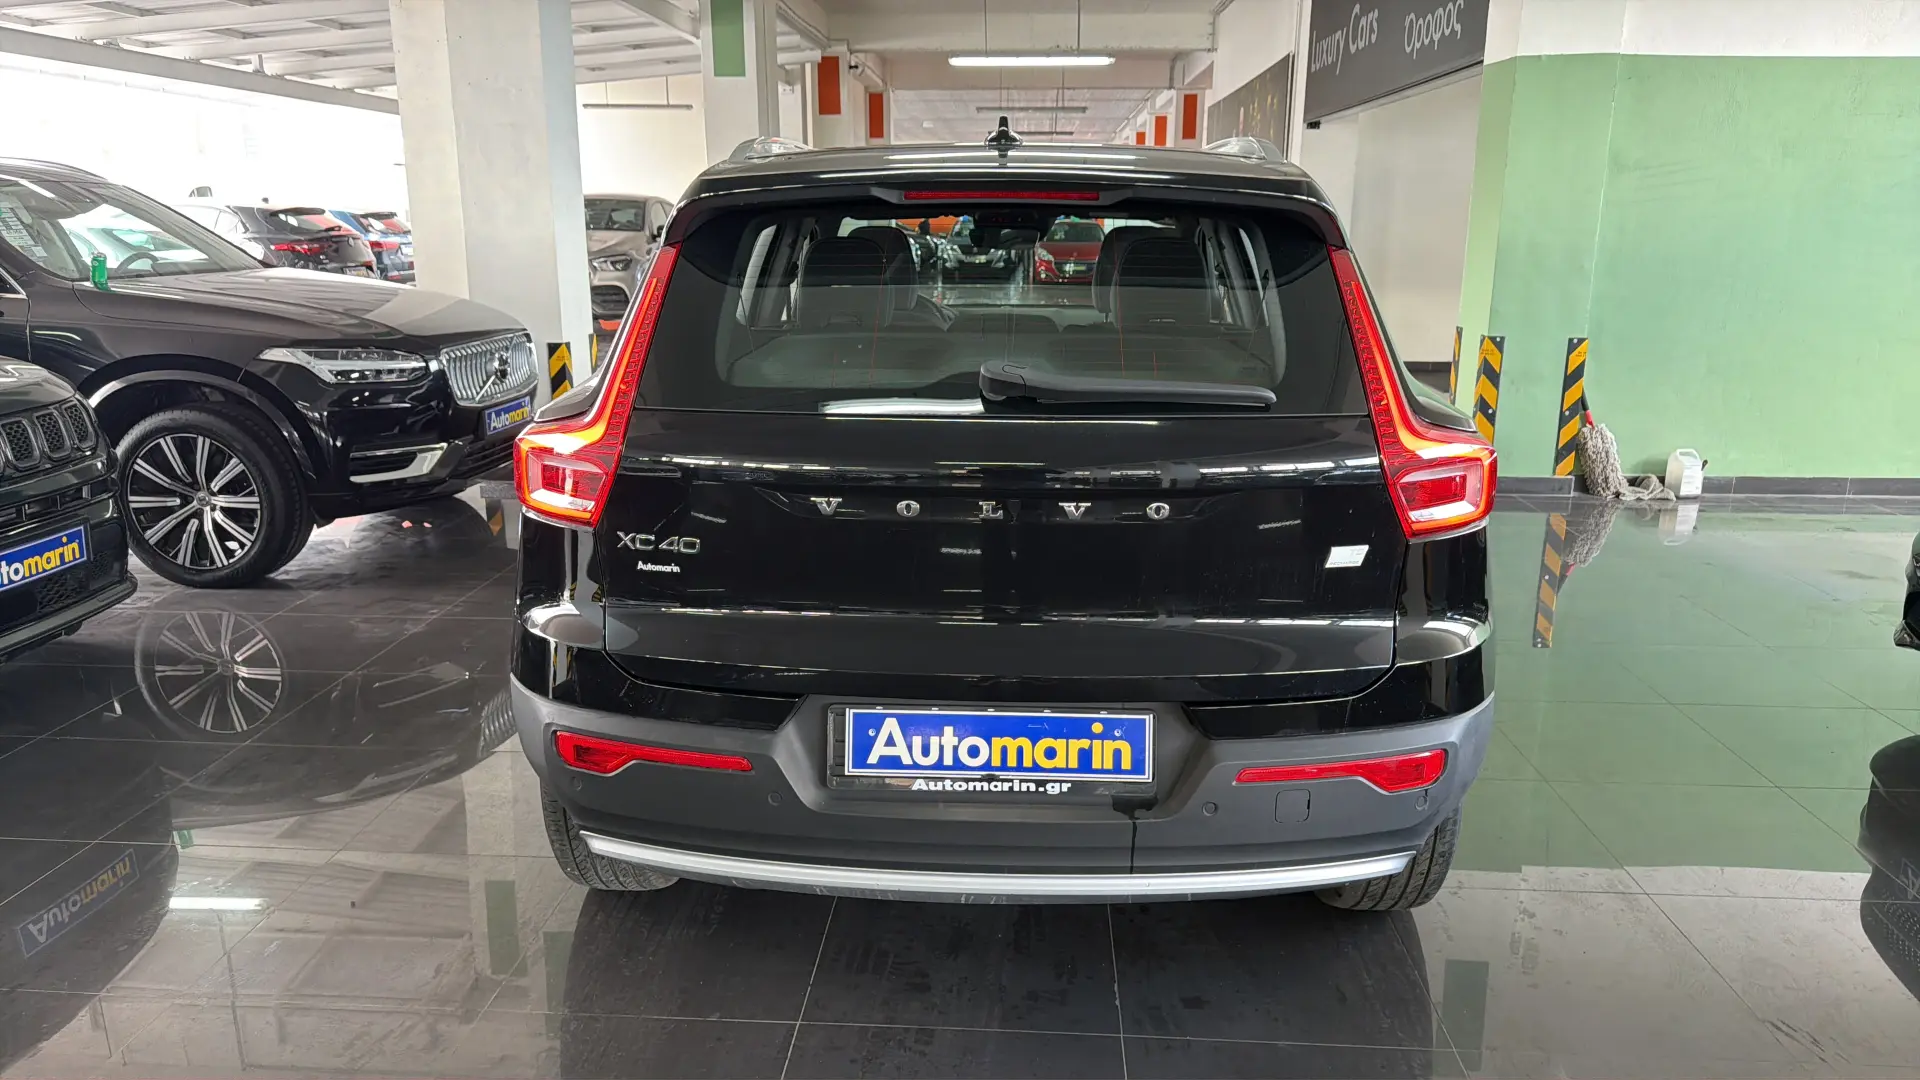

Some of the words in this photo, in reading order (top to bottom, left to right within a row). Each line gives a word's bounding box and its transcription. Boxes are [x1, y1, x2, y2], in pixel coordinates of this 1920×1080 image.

[1311, 27, 1347, 75] Luxury
[1350, 3, 1378, 54] Cars
[810, 497, 1170, 520] VOLVO
[0, 536, 80, 585] tomarin
[637, 560, 681, 573] Automarin
[866, 717, 1132, 770] Automarin
[911, 778, 1072, 794] Automarin.gr
